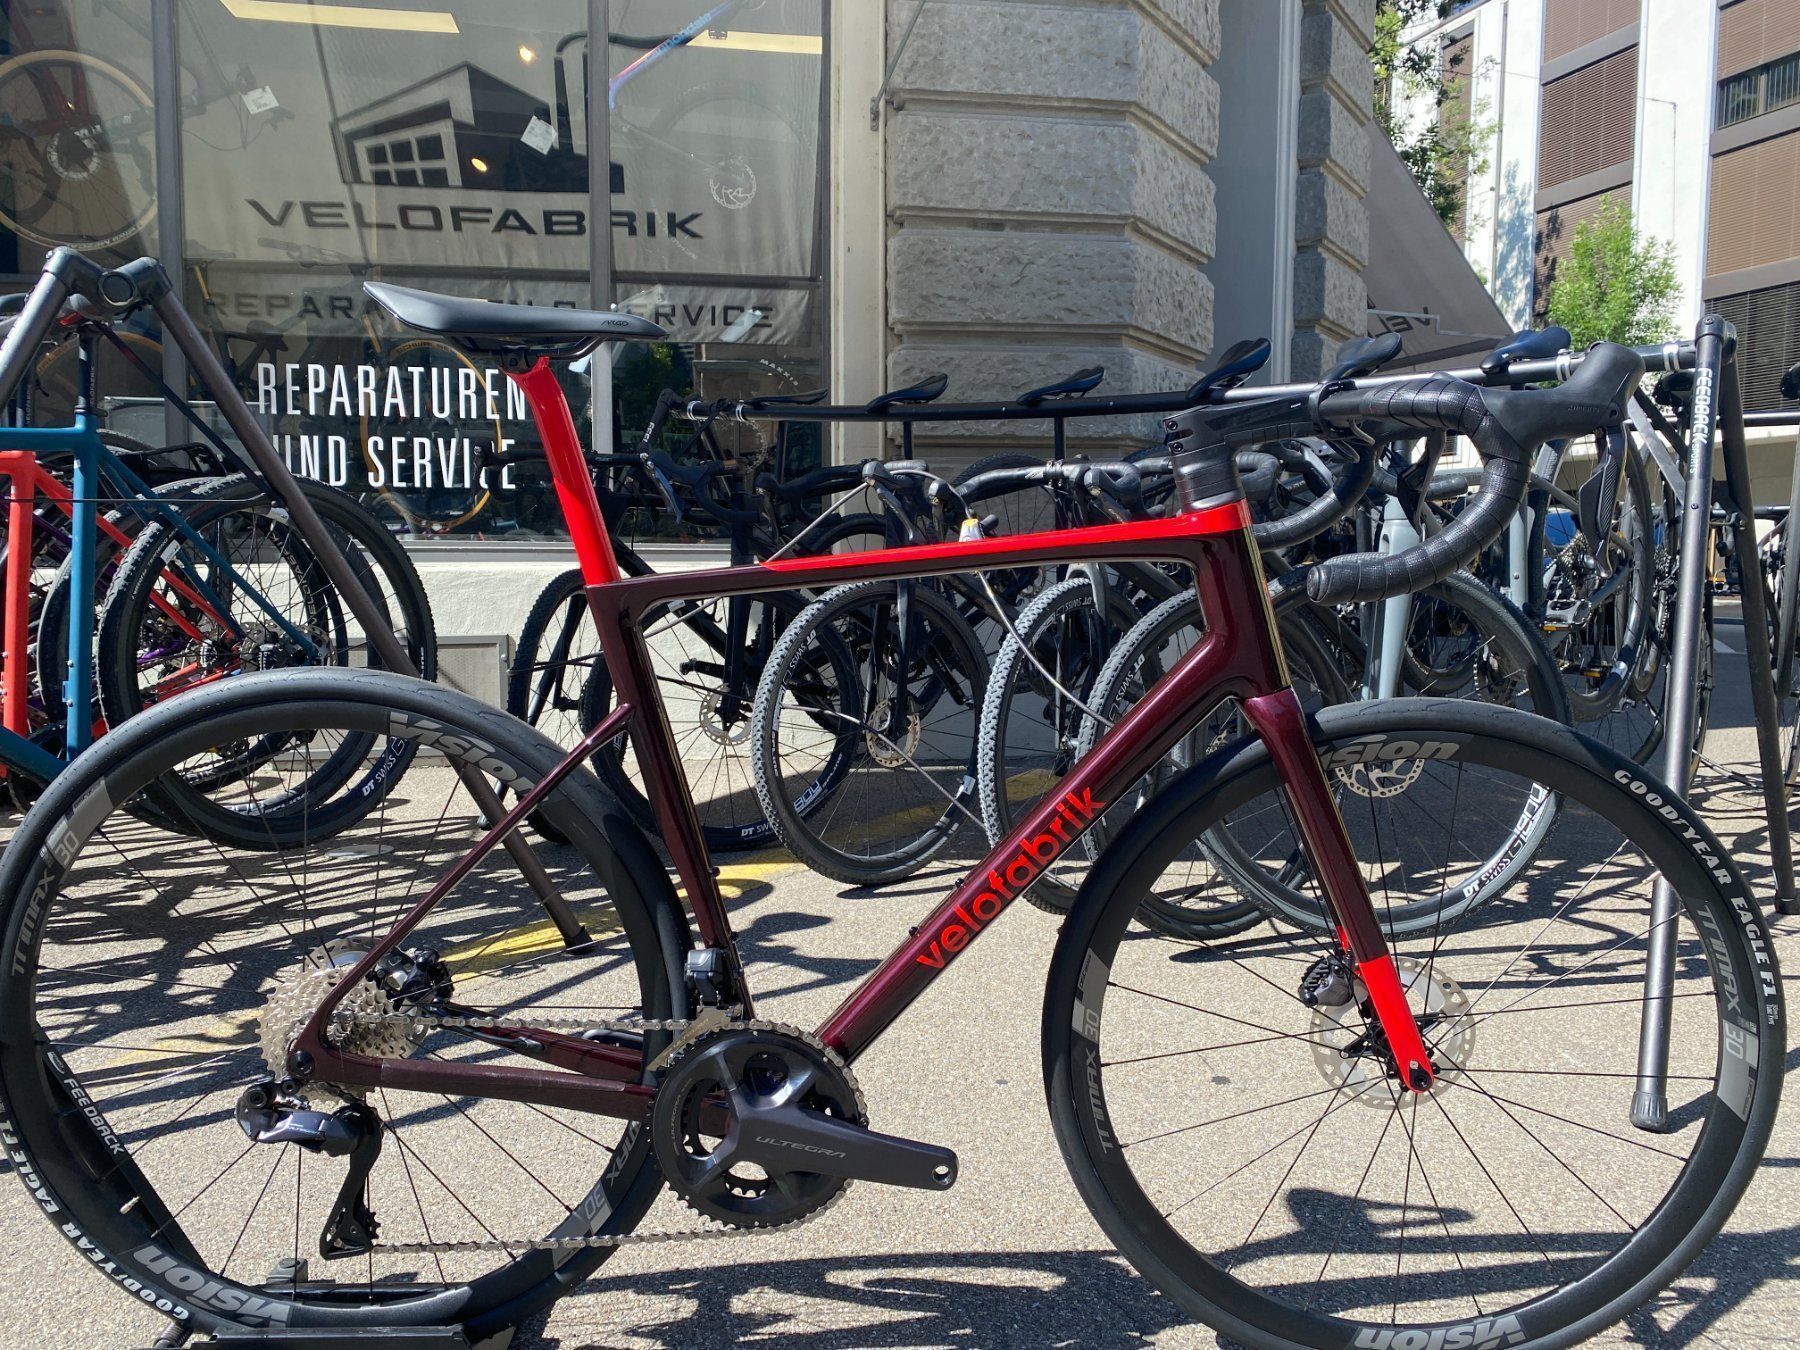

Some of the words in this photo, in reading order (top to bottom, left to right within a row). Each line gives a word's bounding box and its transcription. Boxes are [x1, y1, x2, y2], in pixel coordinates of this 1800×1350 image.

[244, 199, 703, 238] VELOFABRIK
[626, 304, 773, 328] ERVICE
[257, 362, 526, 420] REPARATUREN
[760, 358, 798, 386] MAXXIS
[367, 435, 516, 489] SERVIE
[789, 643, 807, 670] SWISS
[806, 629, 817, 646] DT
[1133, 653, 1146, 673] DT
[1115, 670, 1134, 701] SWISS
[362, 779, 375, 797] DT
[375, 755, 397, 784] SWISS
[55, 829, 80, 867] 30
[916, 786, 1107, 969] velofabrik
[1462, 878, 1480, 898] DT
[1481, 858, 1511, 885] SWISS
[1614, 769, 1733, 886] GOODYEAR
[1730, 896, 1770, 965] EAGLE
[1760, 974, 1776, 997] F1
[1084, 1009, 1100, 1042] 30
[1725, 1022, 1744, 1060] 30
[63, 1078, 125, 1156] FEEDBACK
[755, 1136, 847, 1158] ULTEGRA
[11, 1150, 60, 1214] EAGLE
[61, 1222, 189, 1320] GOODYEAR
